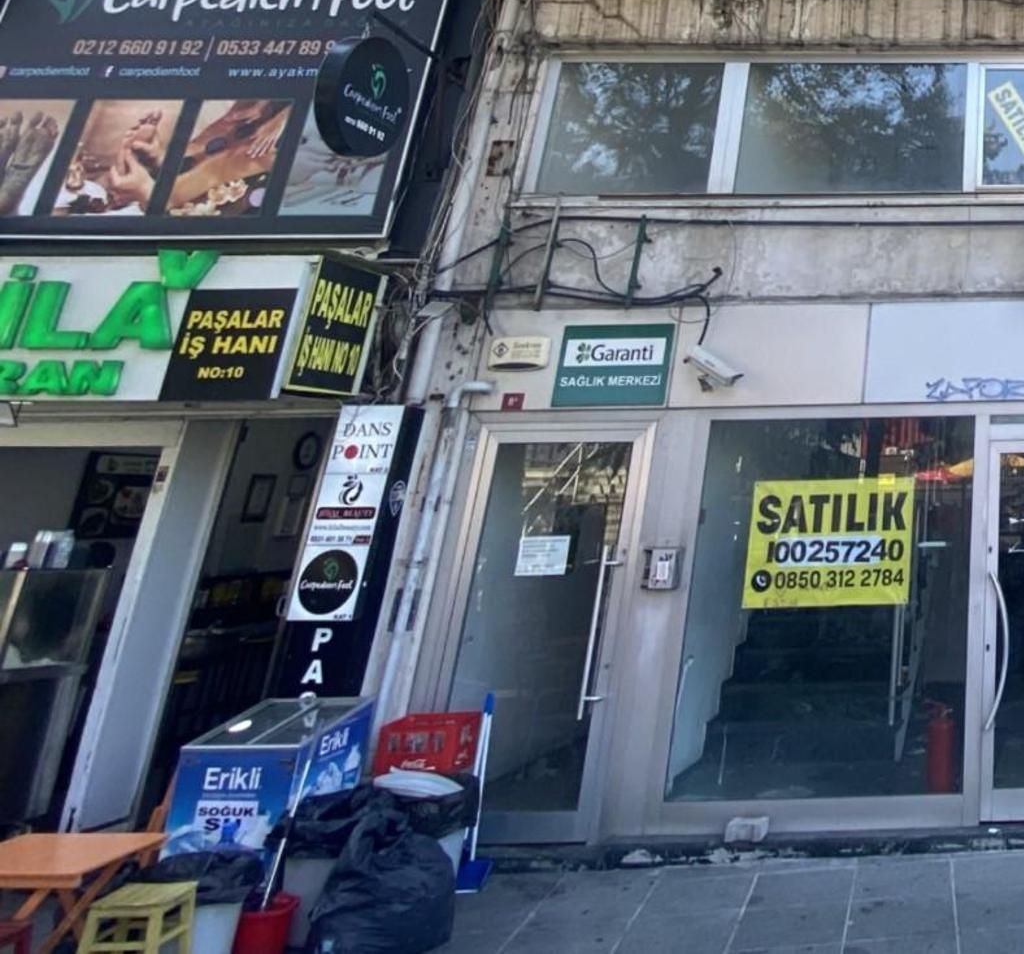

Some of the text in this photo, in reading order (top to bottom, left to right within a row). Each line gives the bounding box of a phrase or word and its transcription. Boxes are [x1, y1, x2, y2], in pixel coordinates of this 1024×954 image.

[73, 39, 117, 56] 0212
[119, 39, 151, 55] 660
[155, 39, 176, 55] 91
[180, 39, 204, 55] 92
[216, 40, 261, 56] 0533
[263, 40, 299, 55] 447
[299, 40, 321, 55] 89
[311, 278, 374, 330] PAŞALAR
[186, 310, 285, 334] PAŞALAR
[179, 331, 279, 359] İŞ HANI
[590, 344, 654, 363] Garanti
[197, 366, 244, 379] NO:10
[560, 373, 662, 387] SAĞLIK MERKEZİ
[343, 422, 393, 438] DANS
[757, 492, 908, 535] SATILIK
[766, 539, 904, 563] 100257240
[774, 568, 905, 589] 0850 312 2784
[320, 727, 350, 756] Erikli
[203, 767, 263, 790] Erikli
[199, 805, 255, 817] SOĞUK
[204, 818, 242, 832] S
